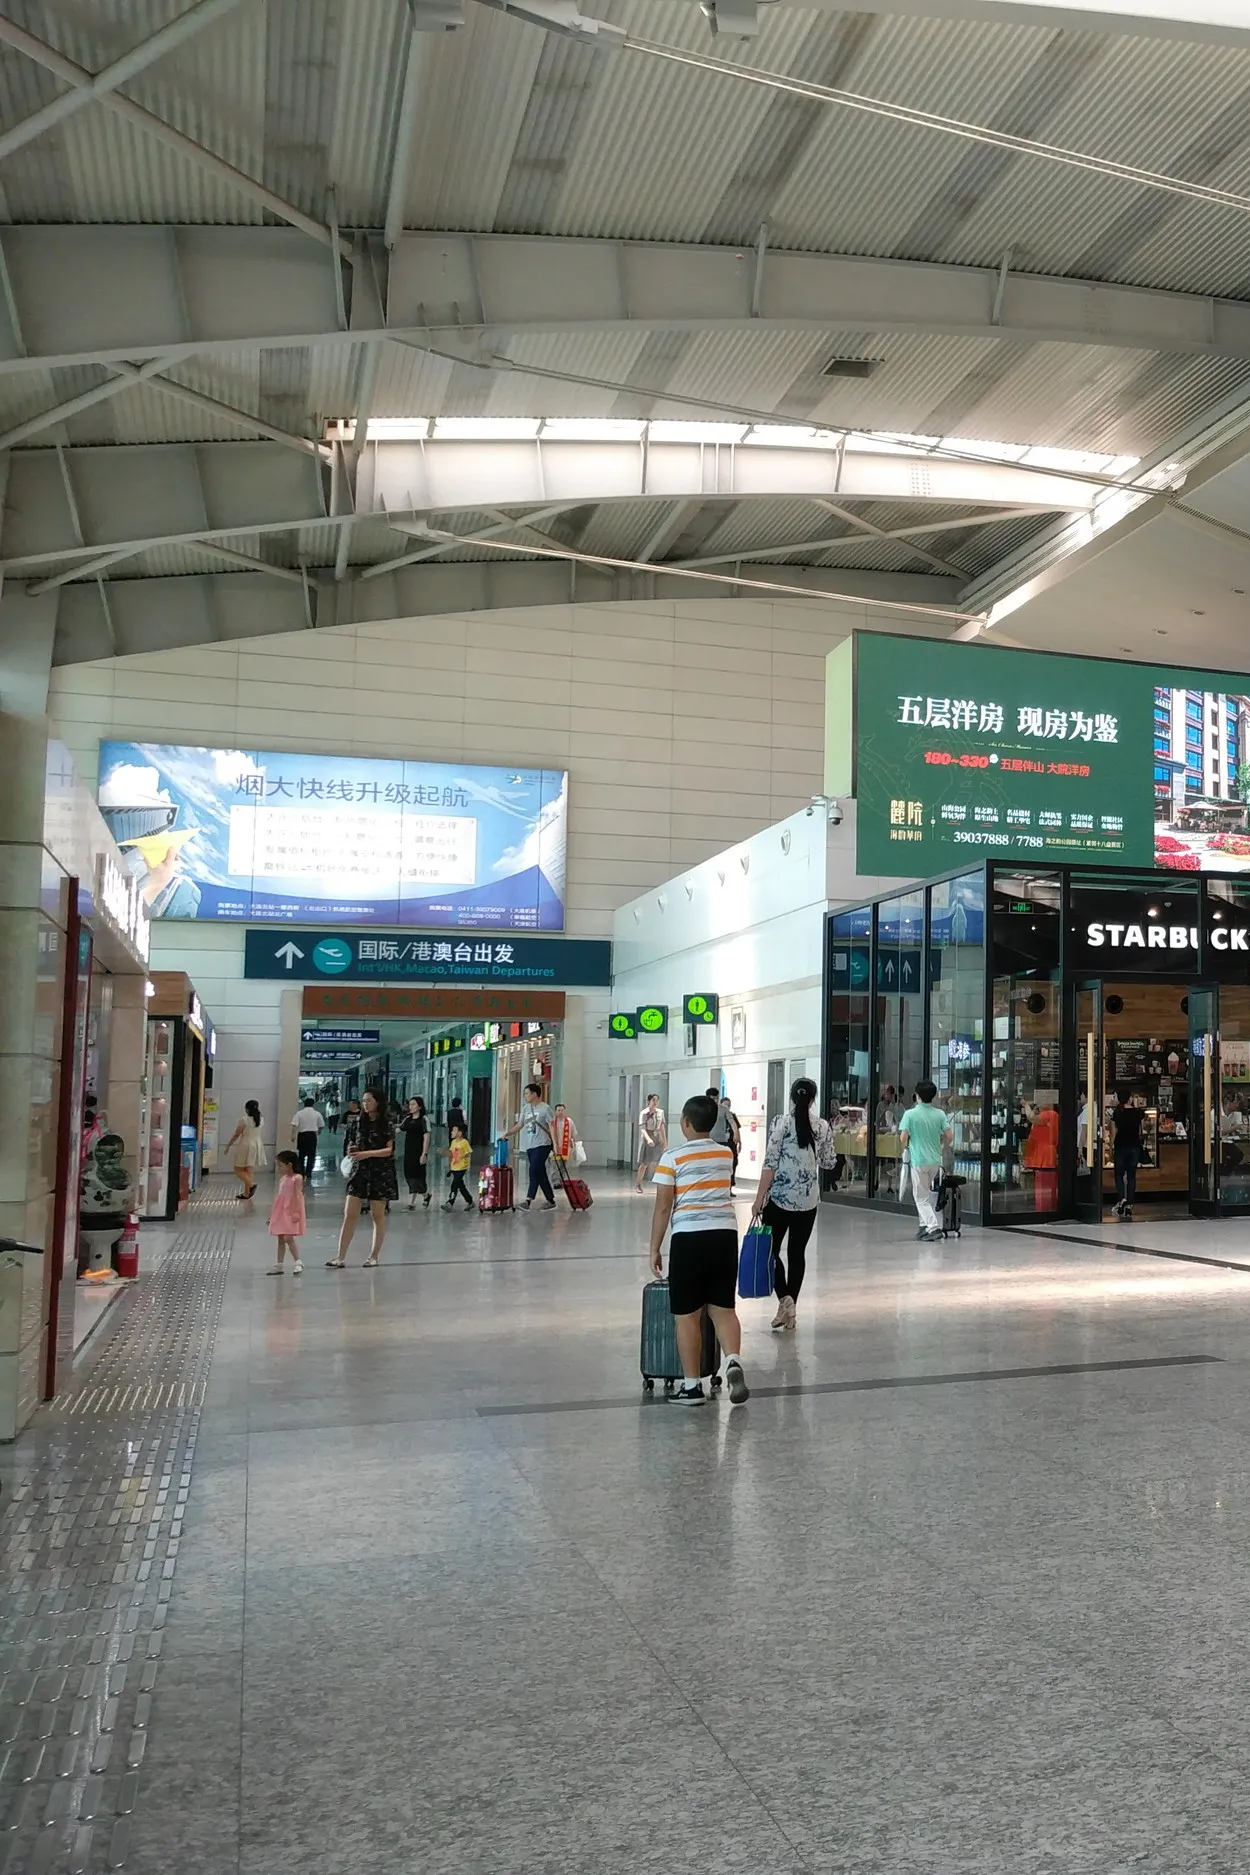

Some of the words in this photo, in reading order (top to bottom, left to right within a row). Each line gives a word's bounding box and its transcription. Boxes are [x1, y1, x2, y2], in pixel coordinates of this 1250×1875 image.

[897, 696, 1004, 734] 五层洋房
[1017, 706, 1118, 744] 现房为鉴
[236, 773, 469, 808] 烟大快线升级起航
[953, 831, 1009, 846] 39037888
[1016, 835, 1044, 848] 7788
[358, 940, 515, 964] 国际/港澳台出发
[492, 966, 555, 977] Departures
